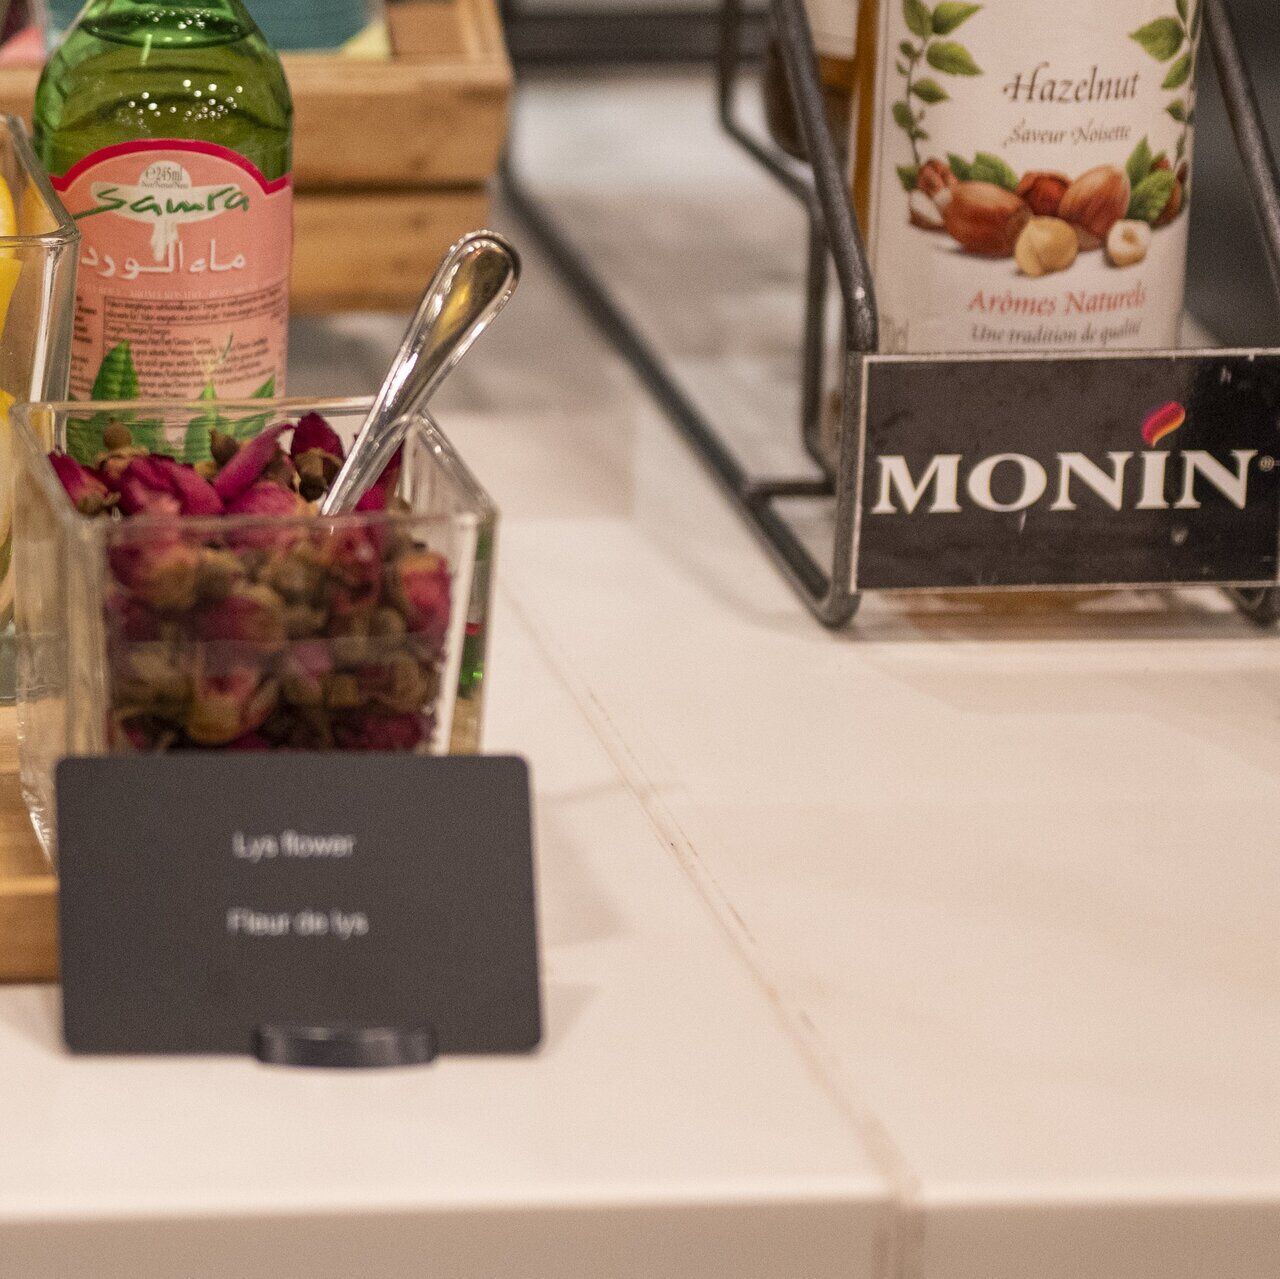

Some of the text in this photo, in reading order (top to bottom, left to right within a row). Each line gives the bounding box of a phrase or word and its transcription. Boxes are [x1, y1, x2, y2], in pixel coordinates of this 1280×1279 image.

[1002, 61, 1140, 104] Hazelnut
[1002, 118, 1132, 147] Saveur Noisette
[73, 186, 251, 219] Samra
[967, 280, 1147, 317] Arômes Naturels
[1009, 323, 1077, 344] tradition
[871, 449, 1258, 515] MONIN
[232, 828, 357, 863] Lys flower
[226, 907, 370, 940] Fleur de lys
